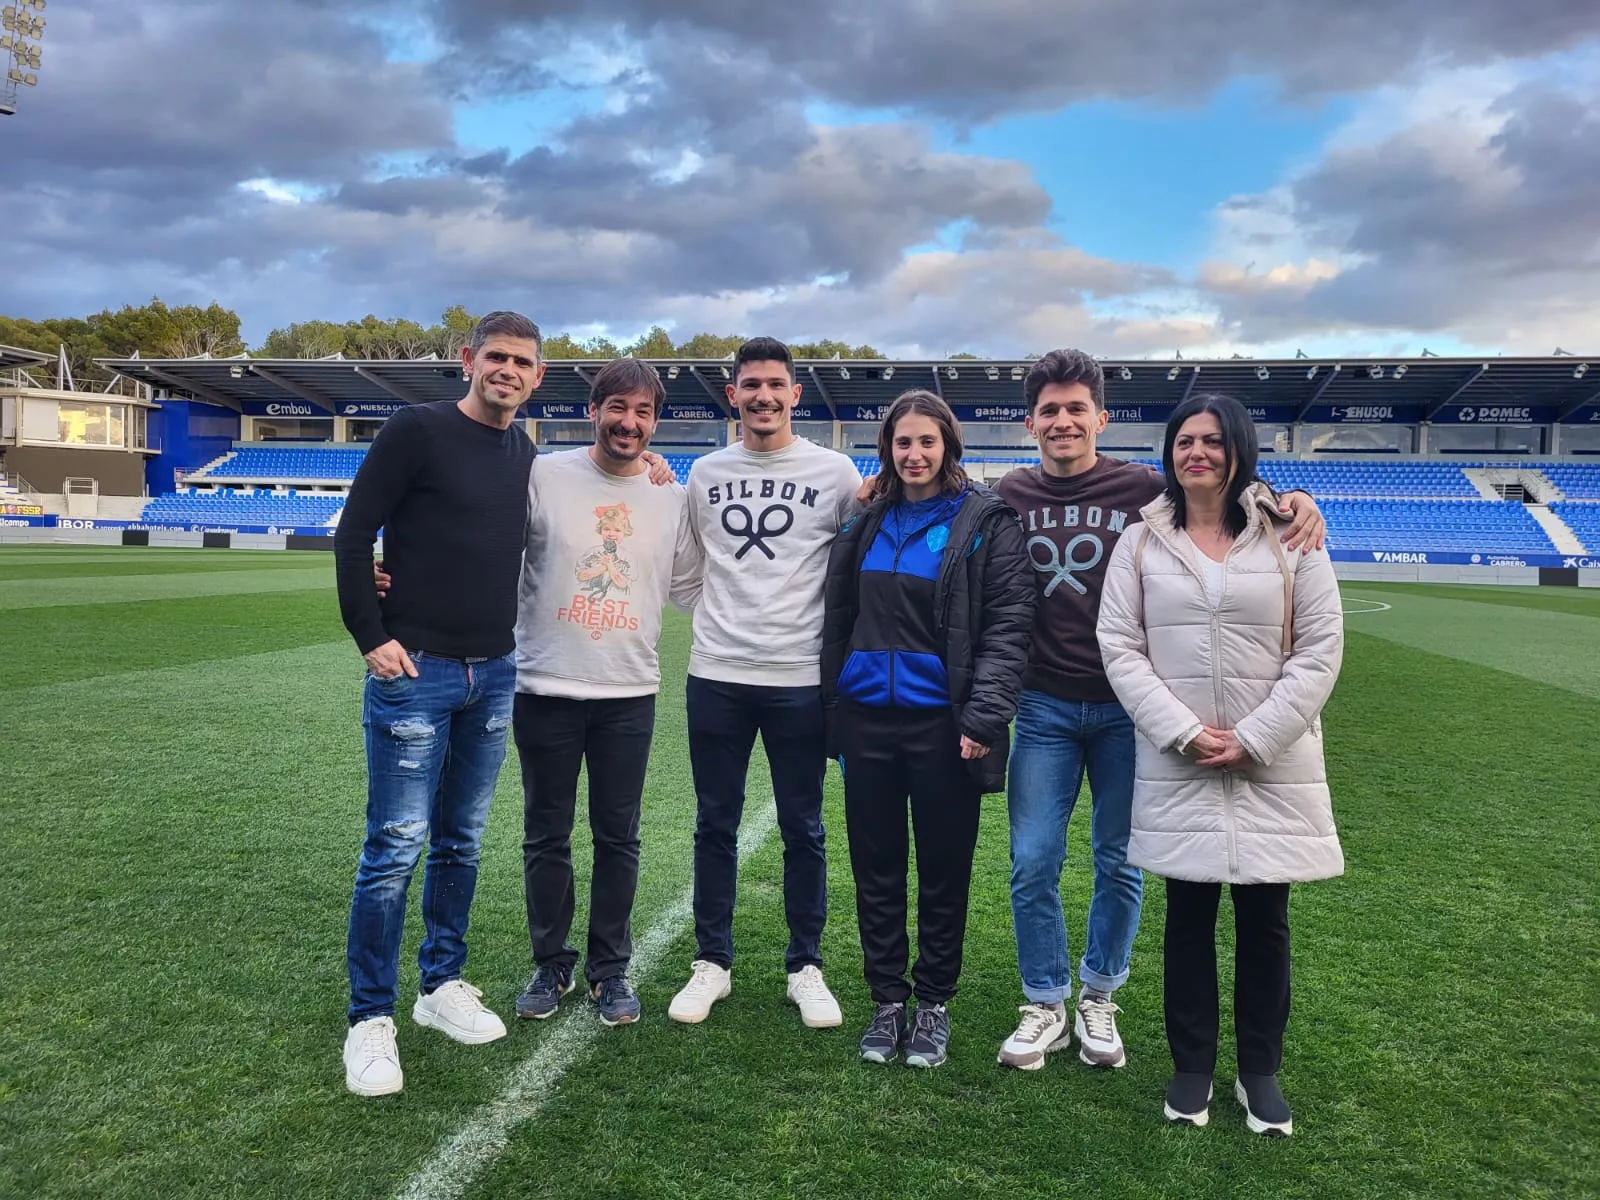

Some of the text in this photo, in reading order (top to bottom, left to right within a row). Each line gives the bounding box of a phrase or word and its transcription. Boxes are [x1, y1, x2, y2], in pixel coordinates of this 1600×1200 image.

[266, 403, 311, 415] embou
[672, 410, 714, 418] CABRERO
[1479, 407, 1530, 417] DOMEC
[708, 479, 819, 508] SILBON
[58, 520, 94, 529] IBOR
[1383, 552, 1427, 563] AMBAR
[572, 594, 630, 616] BEST
[556, 607, 639, 631] FRIENDS
